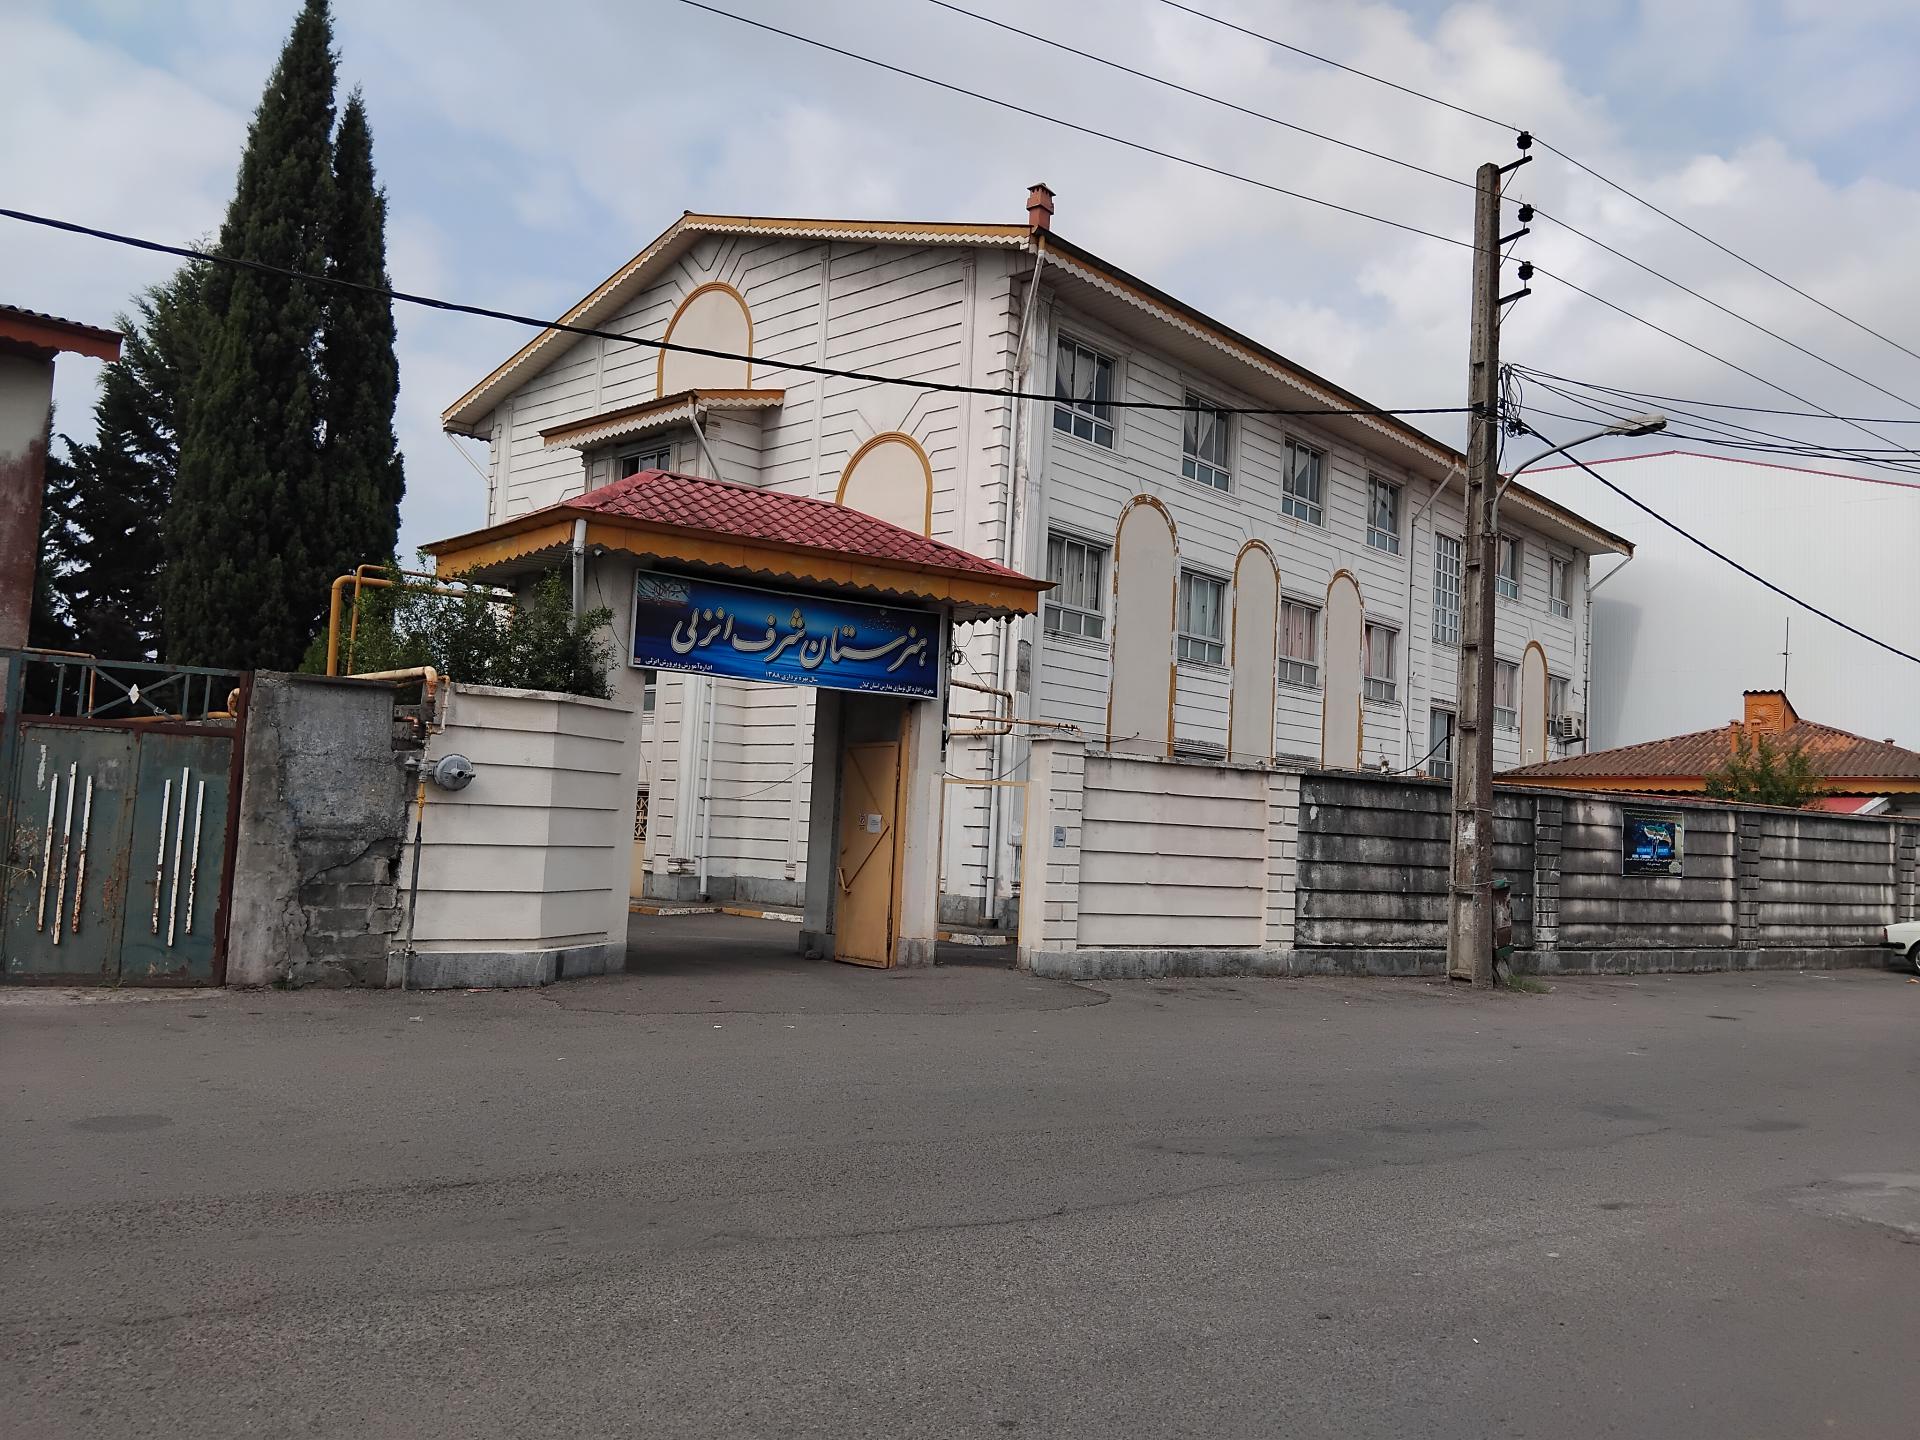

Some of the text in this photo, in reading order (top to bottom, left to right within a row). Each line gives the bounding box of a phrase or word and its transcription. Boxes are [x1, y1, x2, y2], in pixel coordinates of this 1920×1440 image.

[670, 606, 929, 673] هنرستان شرف انزلی
